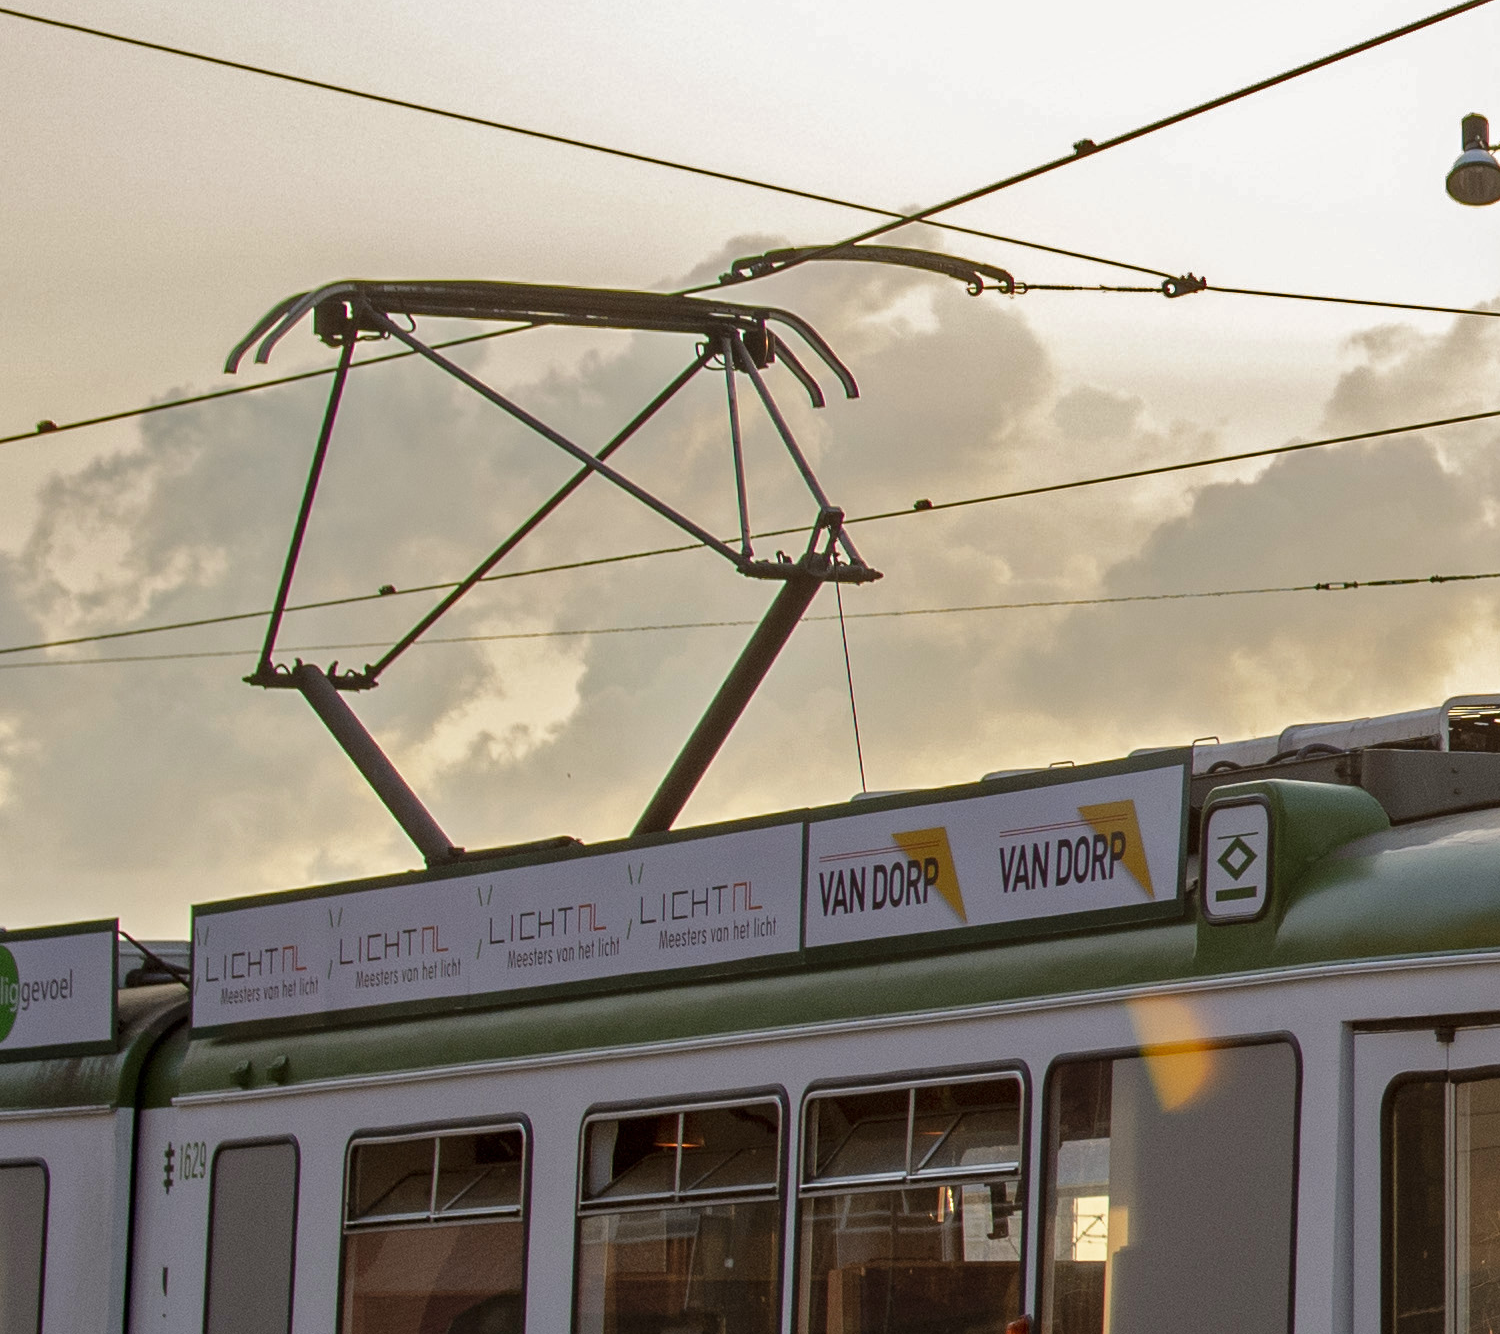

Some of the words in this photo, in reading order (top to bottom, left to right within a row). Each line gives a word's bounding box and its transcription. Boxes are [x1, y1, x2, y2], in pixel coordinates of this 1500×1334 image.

[999, 841, 1050, 893] VAN
[1056, 831, 1126, 886] DORP
[819, 866, 867, 916] VAN
[873, 857, 939, 910] DORP
[659, 927, 707, 950] Meesters
[711, 923, 729, 941] van
[733, 919, 751, 938] het
[753, 915, 777, 938] licht
[507, 948, 553, 968] Meesters
[556, 943, 575, 963] van
[578, 939, 595, 960] het
[598, 936, 620, 957] licht
[355, 968, 398, 989] Meesters
[401, 965, 418, 983] van
[422, 960, 438, 980] het
[441, 958, 461, 979] licht
[220, 987, 261, 1005] Meesters
[263, 986, 280, 1001] van
[282, 980, 297, 998] het
[299, 979, 319, 996] licht
[180, 1141, 207, 1180] 1629
